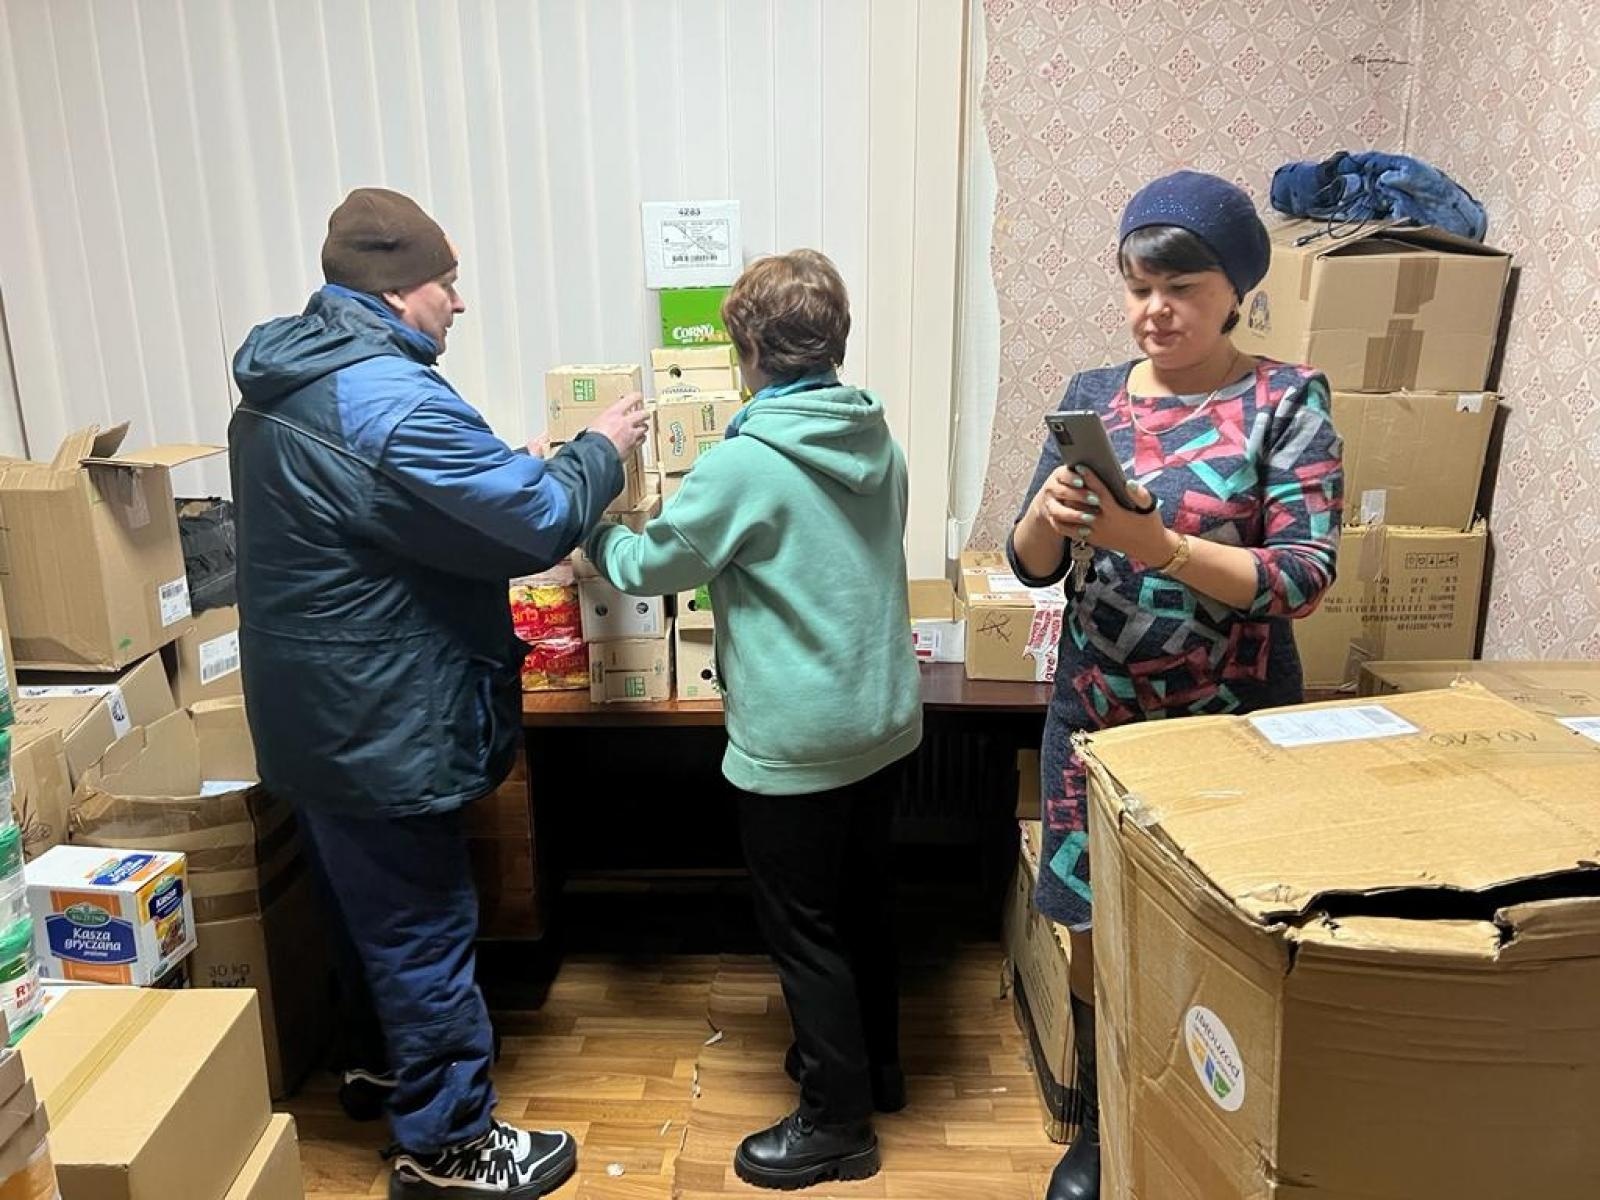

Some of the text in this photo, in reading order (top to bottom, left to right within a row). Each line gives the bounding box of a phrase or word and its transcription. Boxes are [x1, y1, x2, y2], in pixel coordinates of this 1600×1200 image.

[672, 324, 714, 340] CORNY
[73, 927, 111, 941] Kasza
[64, 938, 121, 951] gryczana
